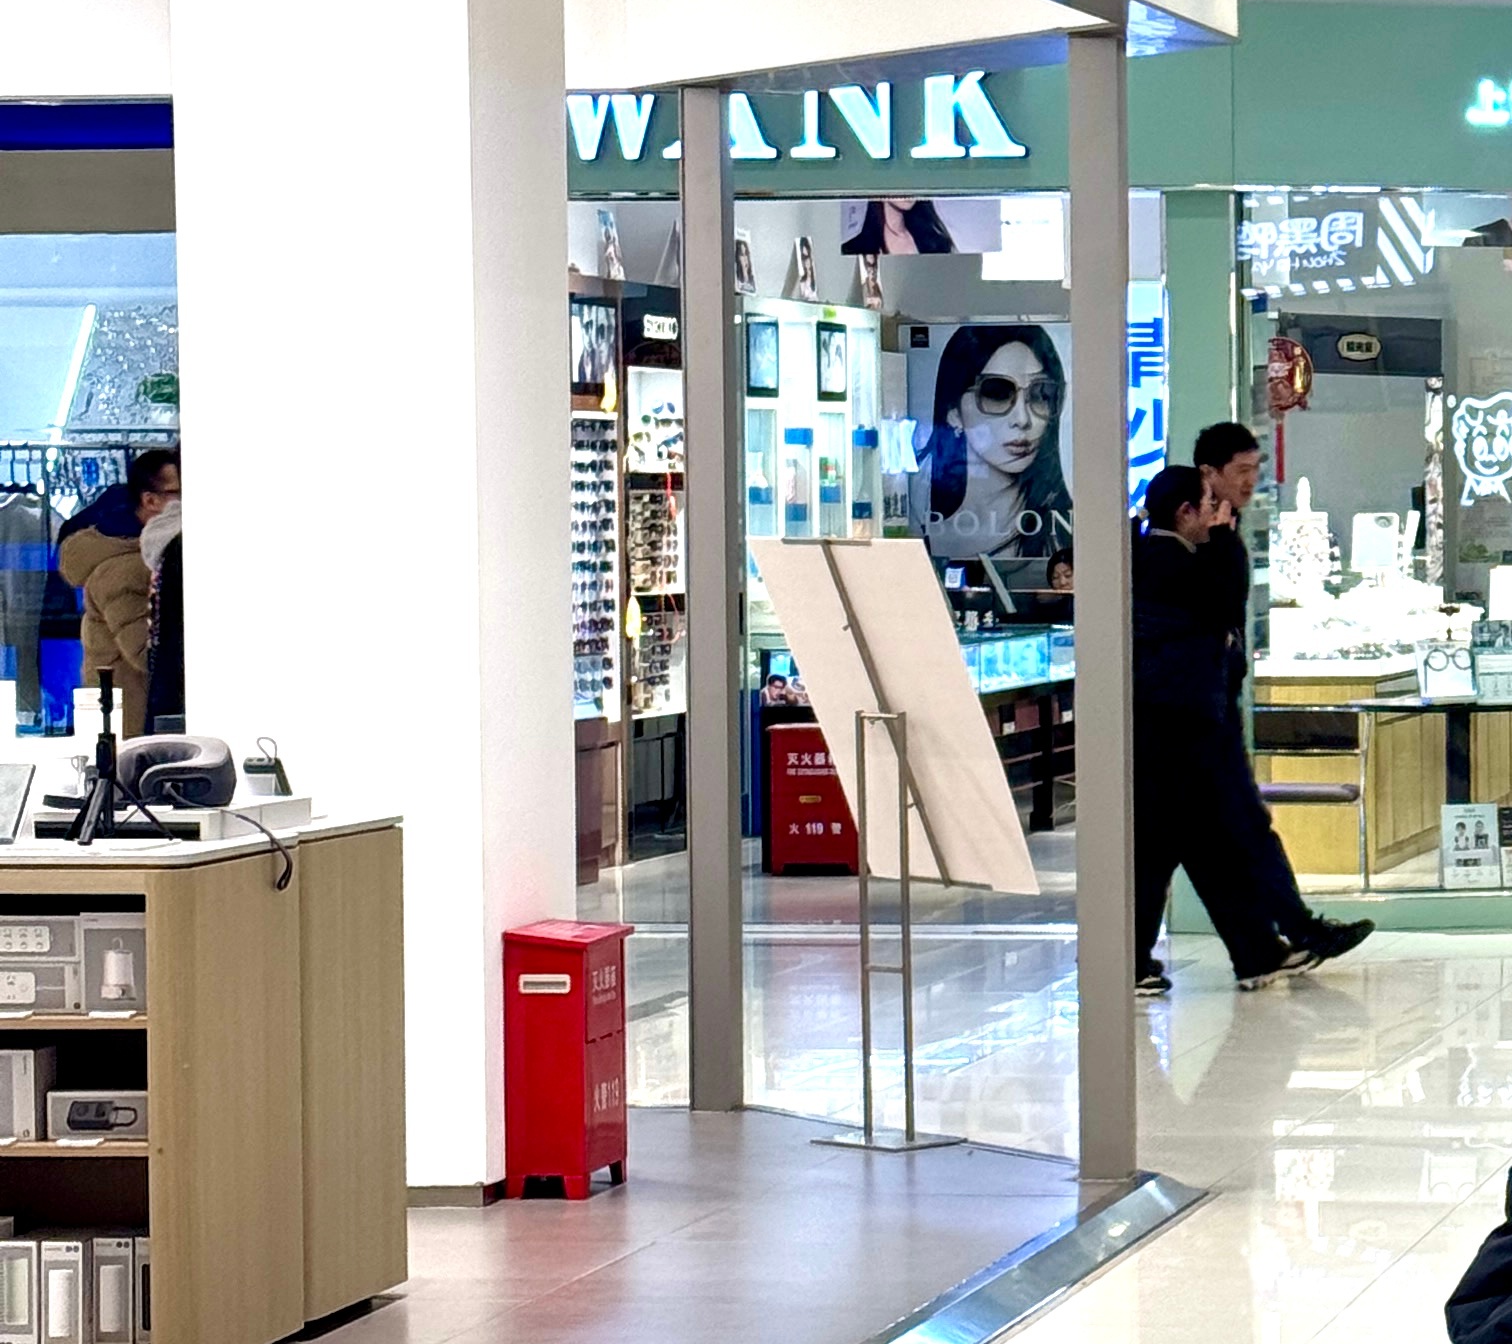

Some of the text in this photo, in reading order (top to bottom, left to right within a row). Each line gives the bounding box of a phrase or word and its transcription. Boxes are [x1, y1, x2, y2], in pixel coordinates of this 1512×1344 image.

[925, 509, 1074, 537] BOLON
[789, 822, 799, 835] 火
[805, 822, 824, 835] 119
